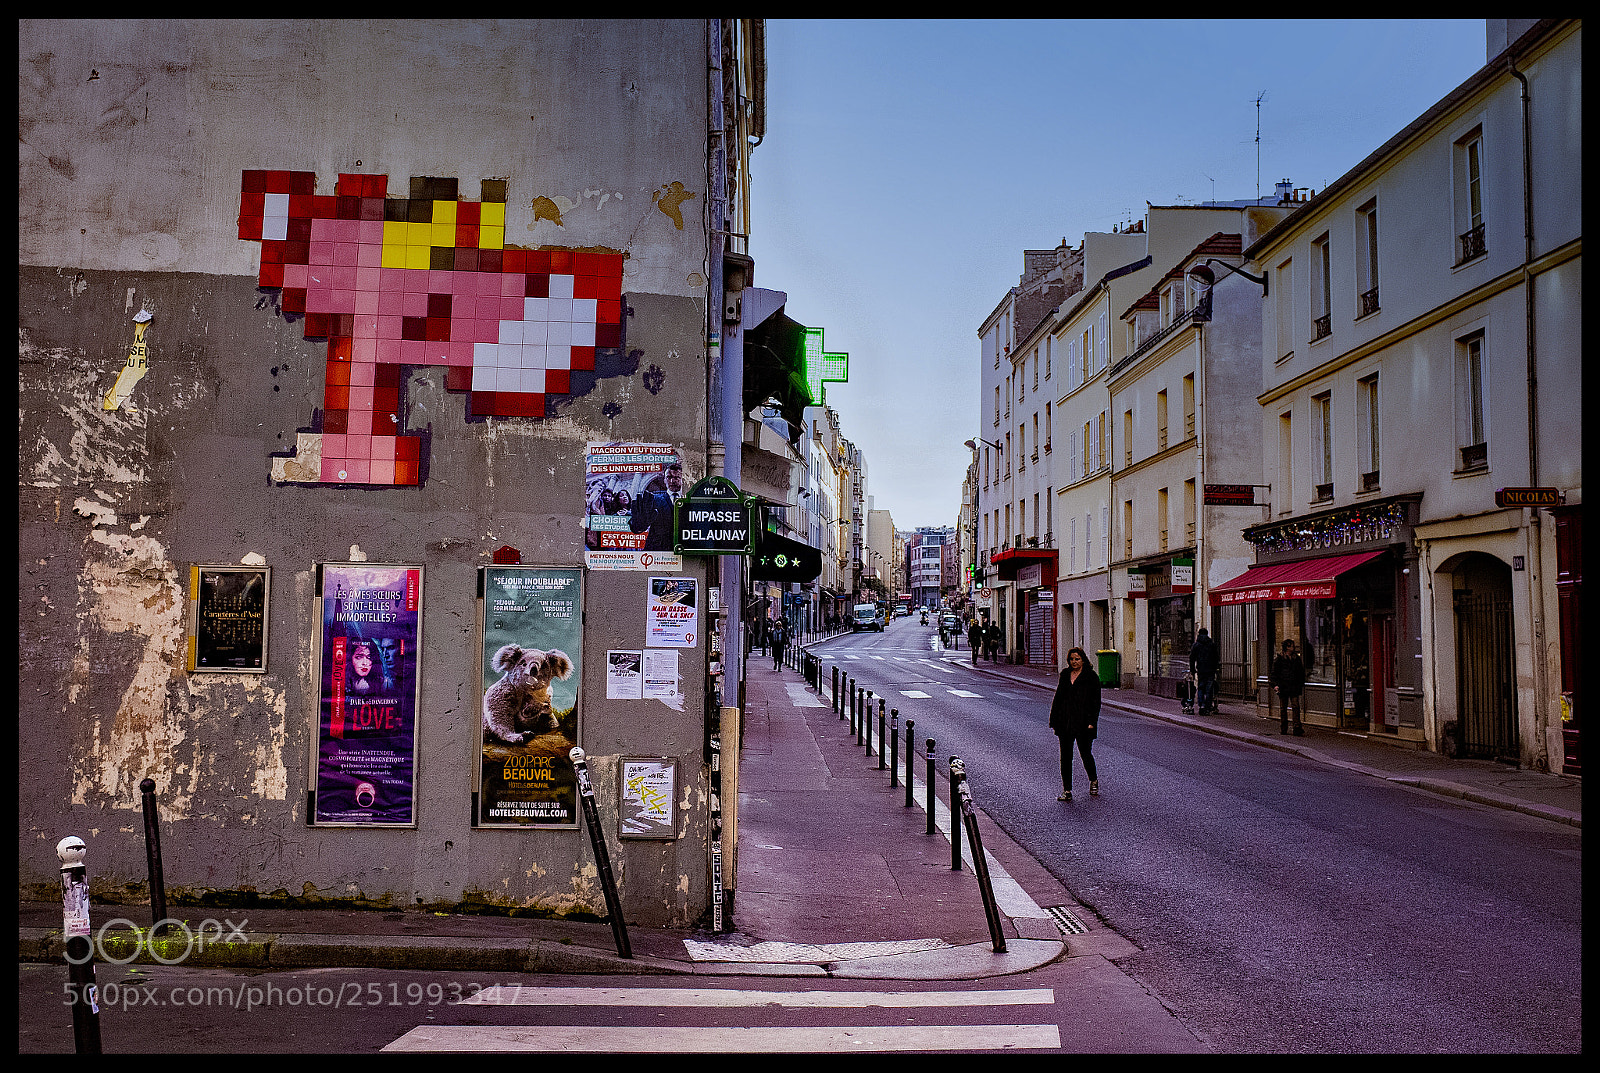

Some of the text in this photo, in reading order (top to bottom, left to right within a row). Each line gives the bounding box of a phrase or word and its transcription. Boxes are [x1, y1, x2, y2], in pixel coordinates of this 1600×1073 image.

[609, 464, 660, 472] UNIVERSITÉS
[1506, 492, 1555, 502] NICOLAS
[688, 511, 741, 522] IMPASSE
[682, 529, 746, 541] DELAUNAY
[334, 588, 401, 600] LES ÂMES SŒURS
[344, 602, 390, 611] SONT-ELLES
[336, 612, 390, 622] IMMORTELLES
[353, 704, 394, 731] LOVE
[504, 754, 555, 768] ZOOPARC
[503, 768, 555, 781] BEAUVAL
[490, 808, 568, 818] HOTELSBEAUVAL.COM
